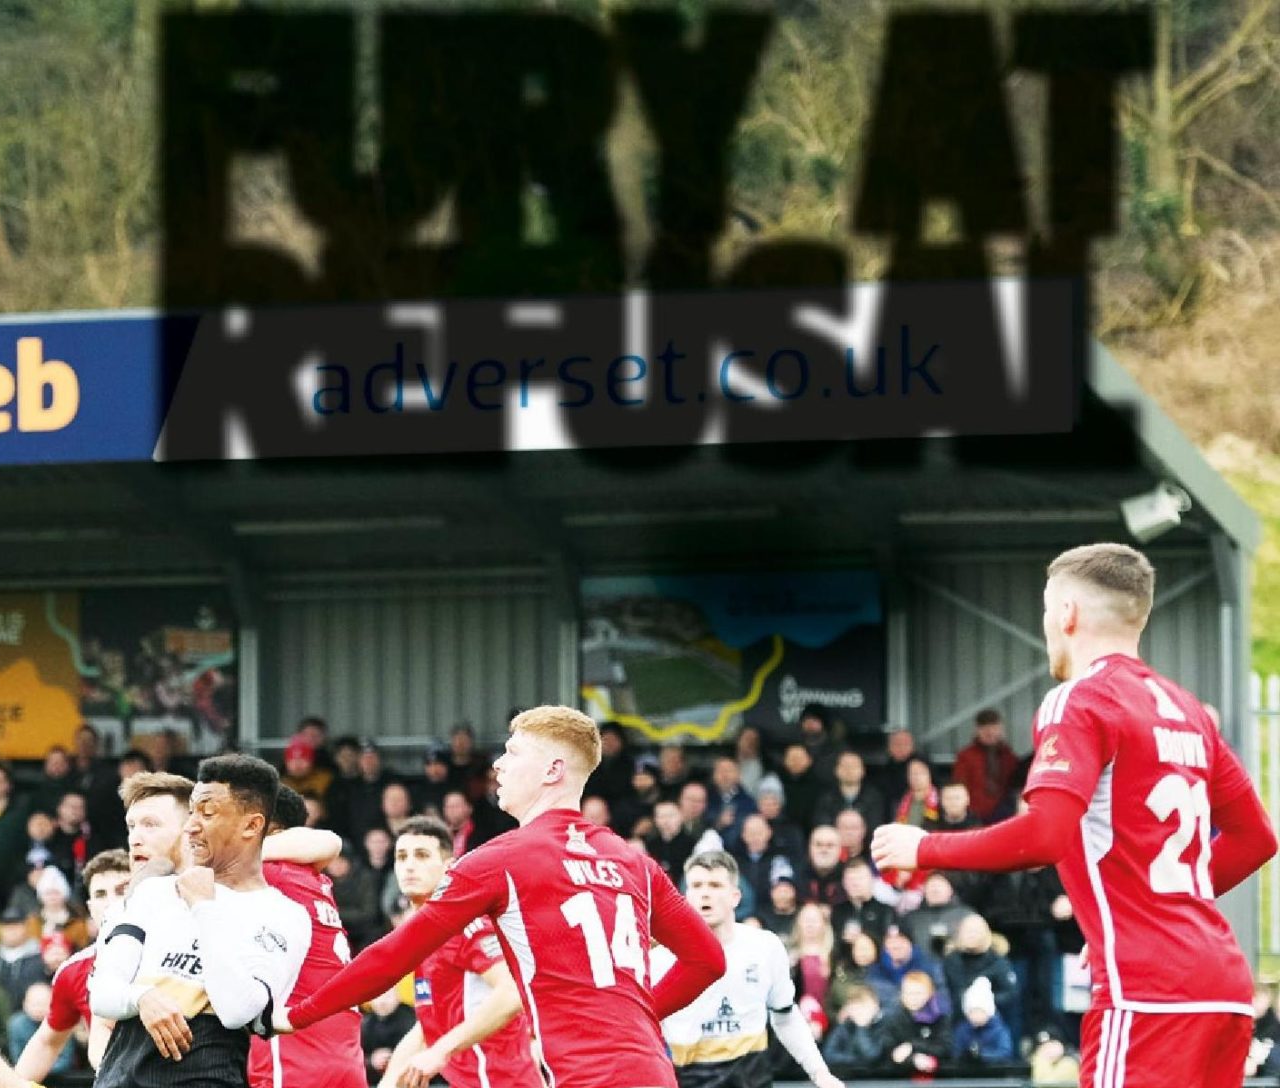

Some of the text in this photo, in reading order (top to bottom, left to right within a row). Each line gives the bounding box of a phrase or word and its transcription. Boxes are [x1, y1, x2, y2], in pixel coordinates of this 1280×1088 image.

[312, 323, 946, 416] adverset.co.uk
[563, 860, 624, 887] WILES
[1145, 774, 1214, 899] 21
[161, 952, 203, 975] HITE
[560, 891, 646, 989] 14
